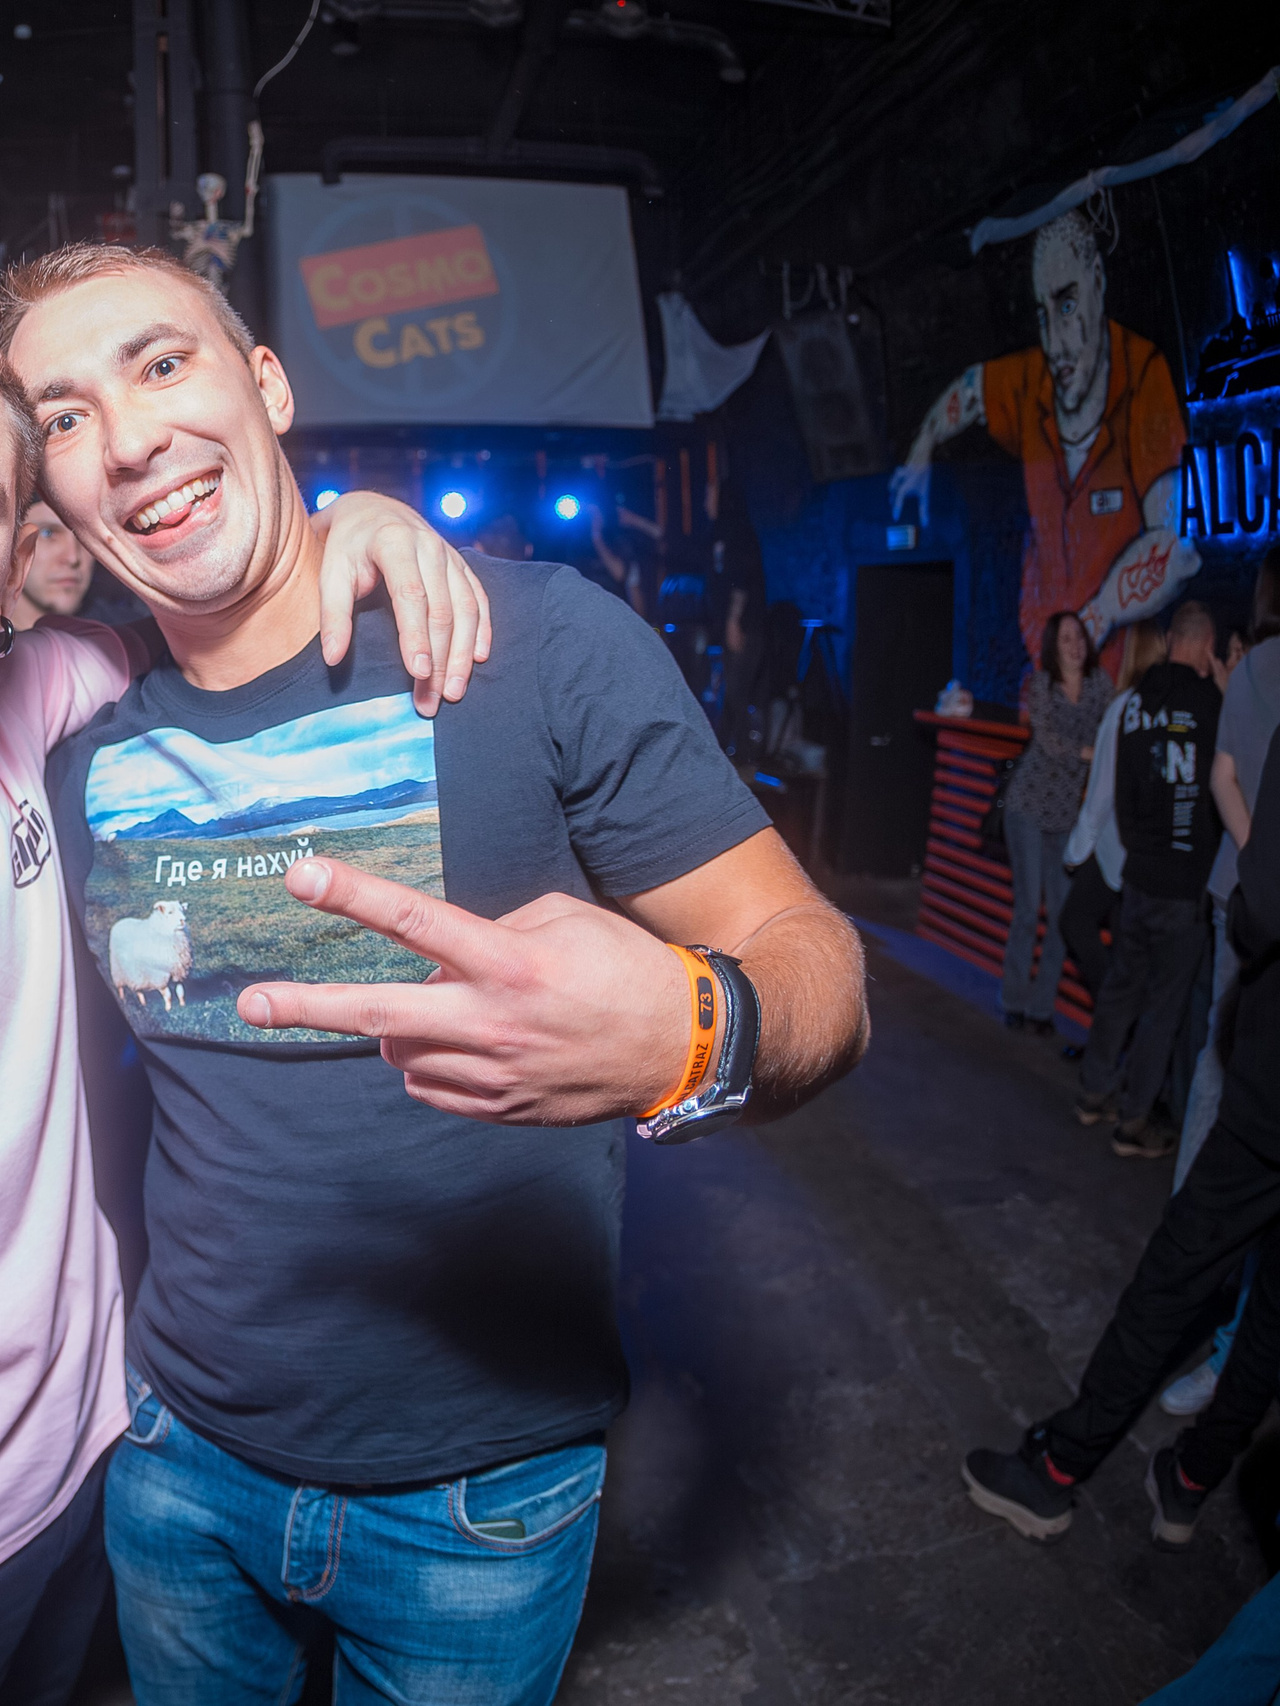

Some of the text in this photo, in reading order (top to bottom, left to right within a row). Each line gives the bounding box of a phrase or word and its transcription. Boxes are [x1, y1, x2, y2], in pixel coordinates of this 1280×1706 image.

[310, 248, 490, 312] COSMO
[353, 314, 485, 370] CATS
[155, 855, 203, 887] Где
[211, 858, 227, 880] я
[700, 992, 712, 1014] 73
